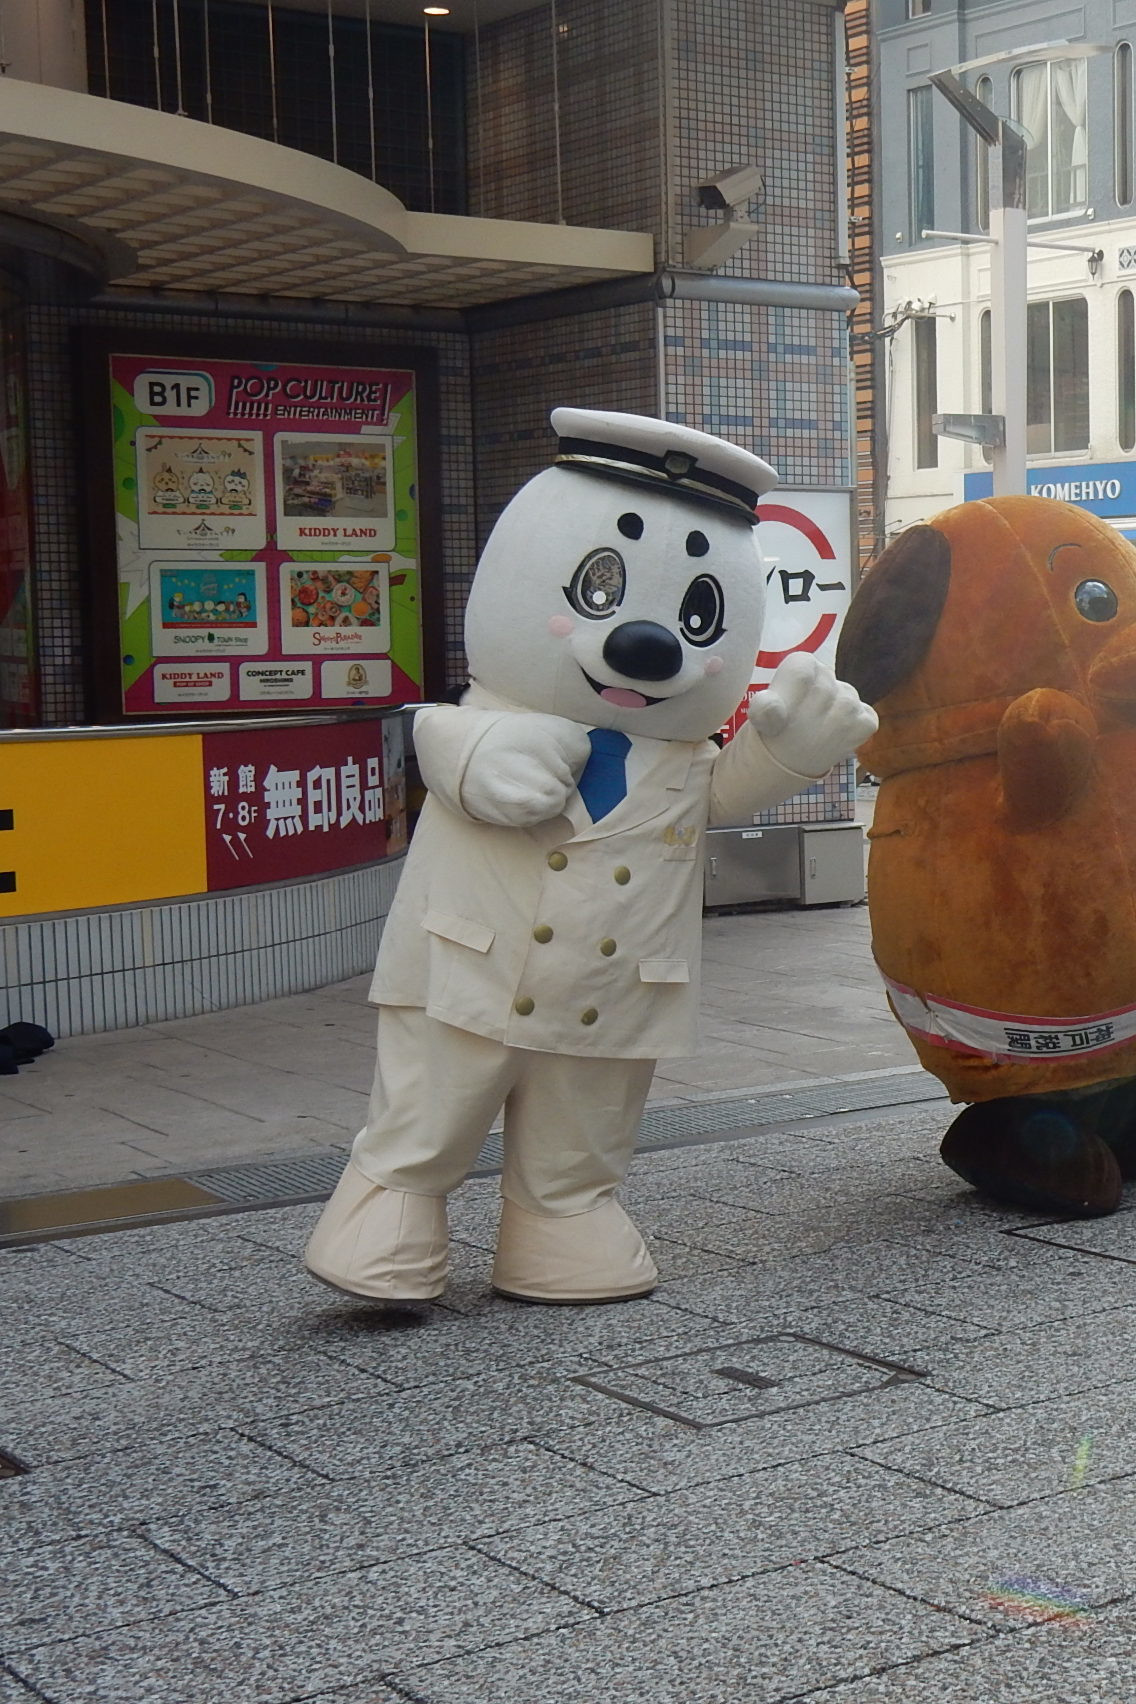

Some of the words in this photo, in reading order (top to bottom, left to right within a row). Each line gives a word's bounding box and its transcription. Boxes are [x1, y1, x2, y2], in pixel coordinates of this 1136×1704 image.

[148, 382, 201, 408] B1F
[229, 376, 282, 402] POP
[276, 405, 381, 423] ENTERTAINMENT
[1031, 479, 1121, 502] KOMEHYO
[298, 527, 340, 538] KIDDY
[342, 527, 377, 538] LAND
[766, 565, 847, 605] ロー
[161, 672, 193, 680] KIDDY
[196, 671, 224, 680] LAND
[246, 669, 283, 677] CONCEPT
[209, 764, 256, 797] 新館
[263, 756, 384, 840] 無印良品
[1005, 1023, 1115, 1051] 神戸税関
